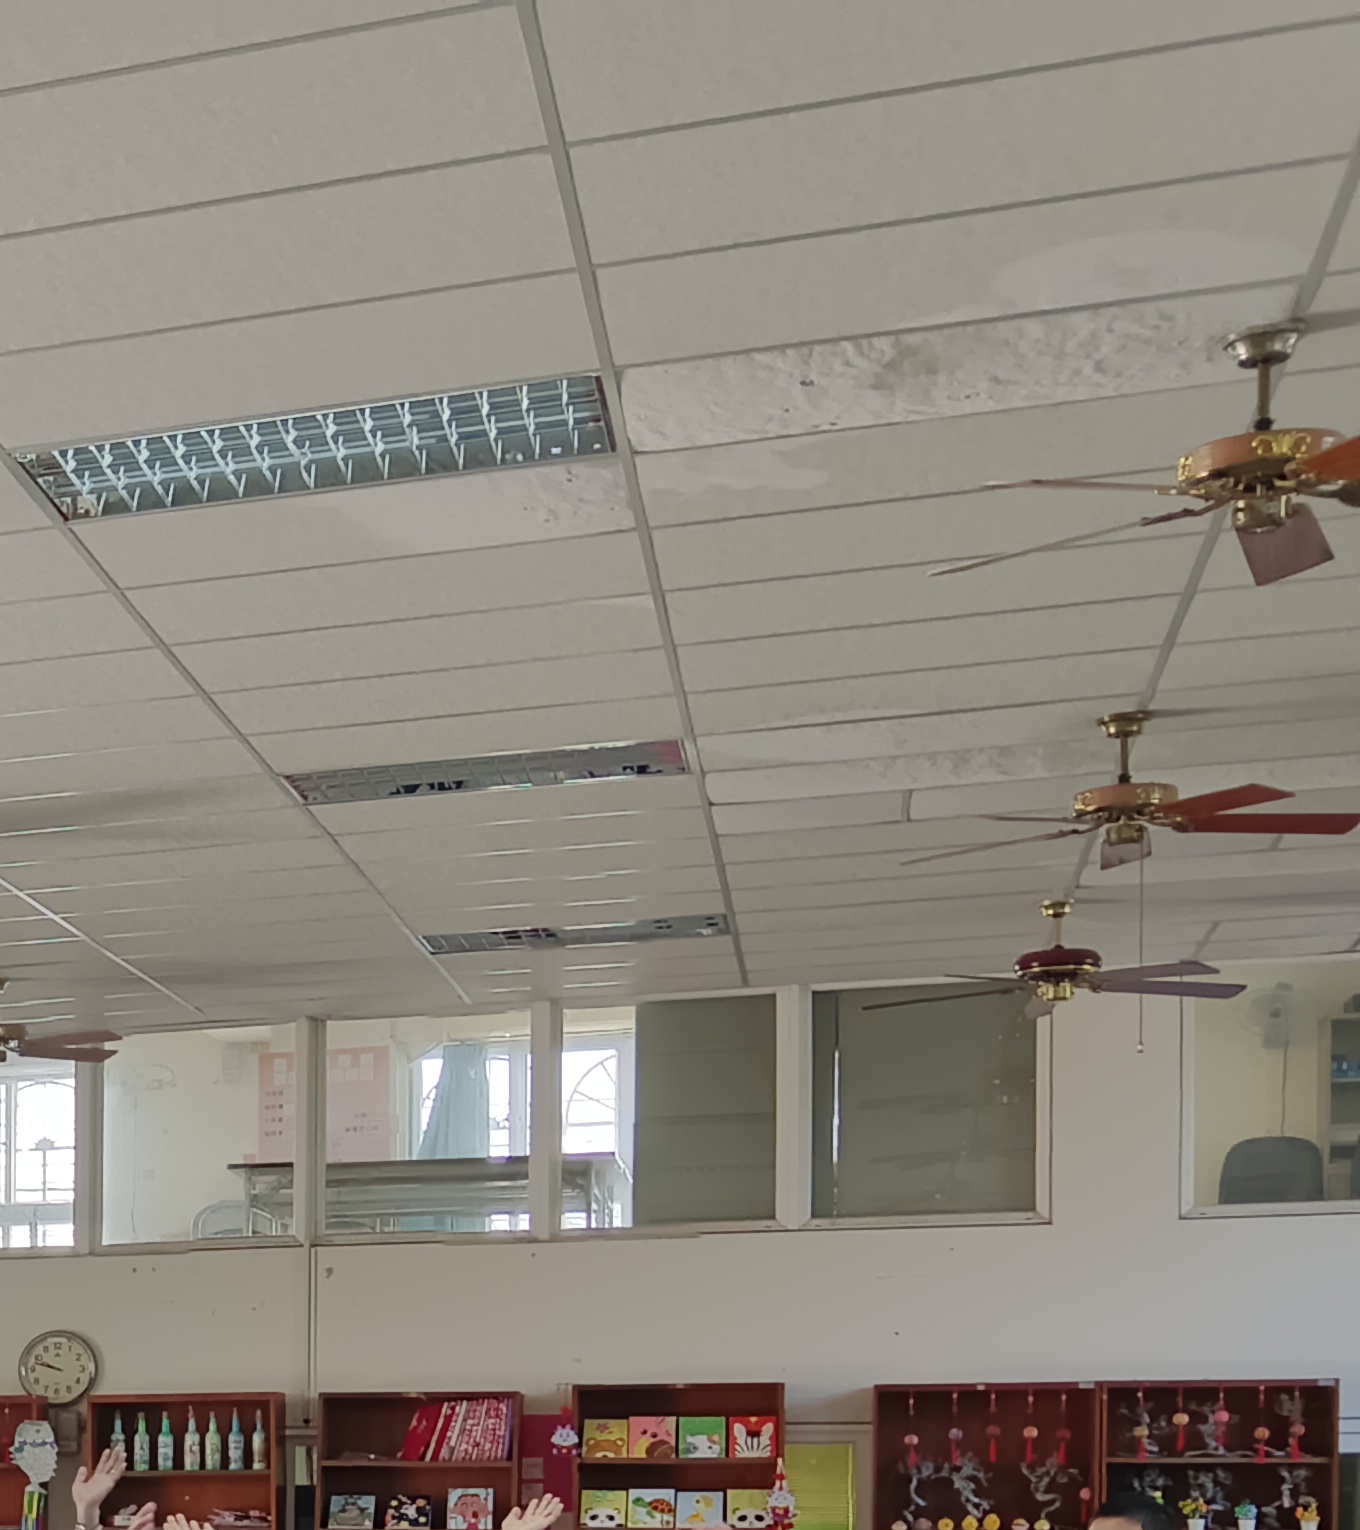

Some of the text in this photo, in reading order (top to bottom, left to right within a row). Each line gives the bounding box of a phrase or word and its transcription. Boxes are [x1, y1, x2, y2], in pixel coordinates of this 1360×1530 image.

[54, 1342, 62, 1350] 12
[69, 1345, 72, 1353] 1
[34, 1354, 43, 1362] 10
[76, 1353, 81, 1361] 2
[30, 1365, 36, 1373] 9
[79, 1365, 85, 1373] 3
[34, 1377, 40, 1385] 8
[76, 1377, 81, 1385] 4
[44, 1385, 49, 1394] 7
[54, 1388, 60, 1396] 6
[66, 1385, 72, 1394] 5
